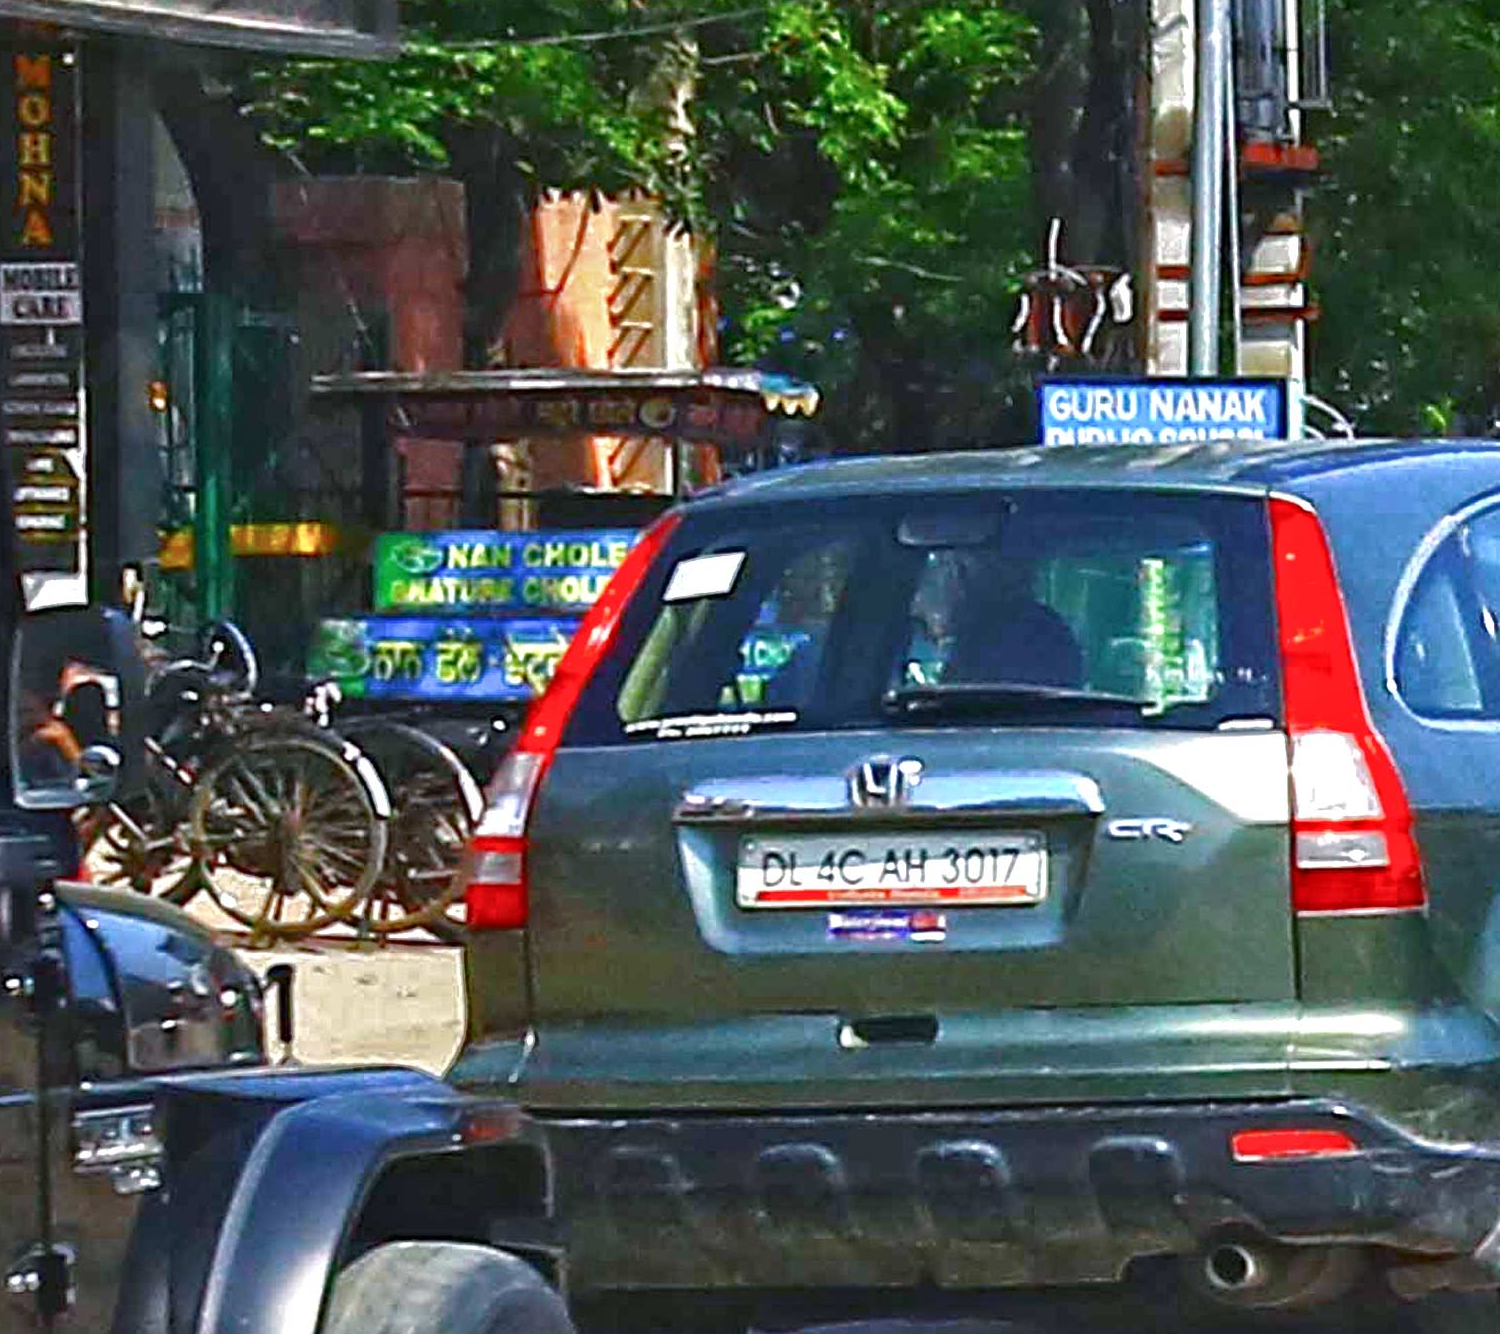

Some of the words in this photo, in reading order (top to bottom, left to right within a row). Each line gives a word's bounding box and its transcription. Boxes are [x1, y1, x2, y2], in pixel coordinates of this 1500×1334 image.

[1049, 388, 1138, 422] GURU
[1150, 388, 1267, 423] NANAK
[447, 543, 511, 568] NAN
[523, 543, 629, 567] CHOLE
[763, 852, 799, 886] DL
[815, 849, 867, 884] 4C
[878, 848, 927, 884] AH
[941, 847, 1022, 884] 3017
